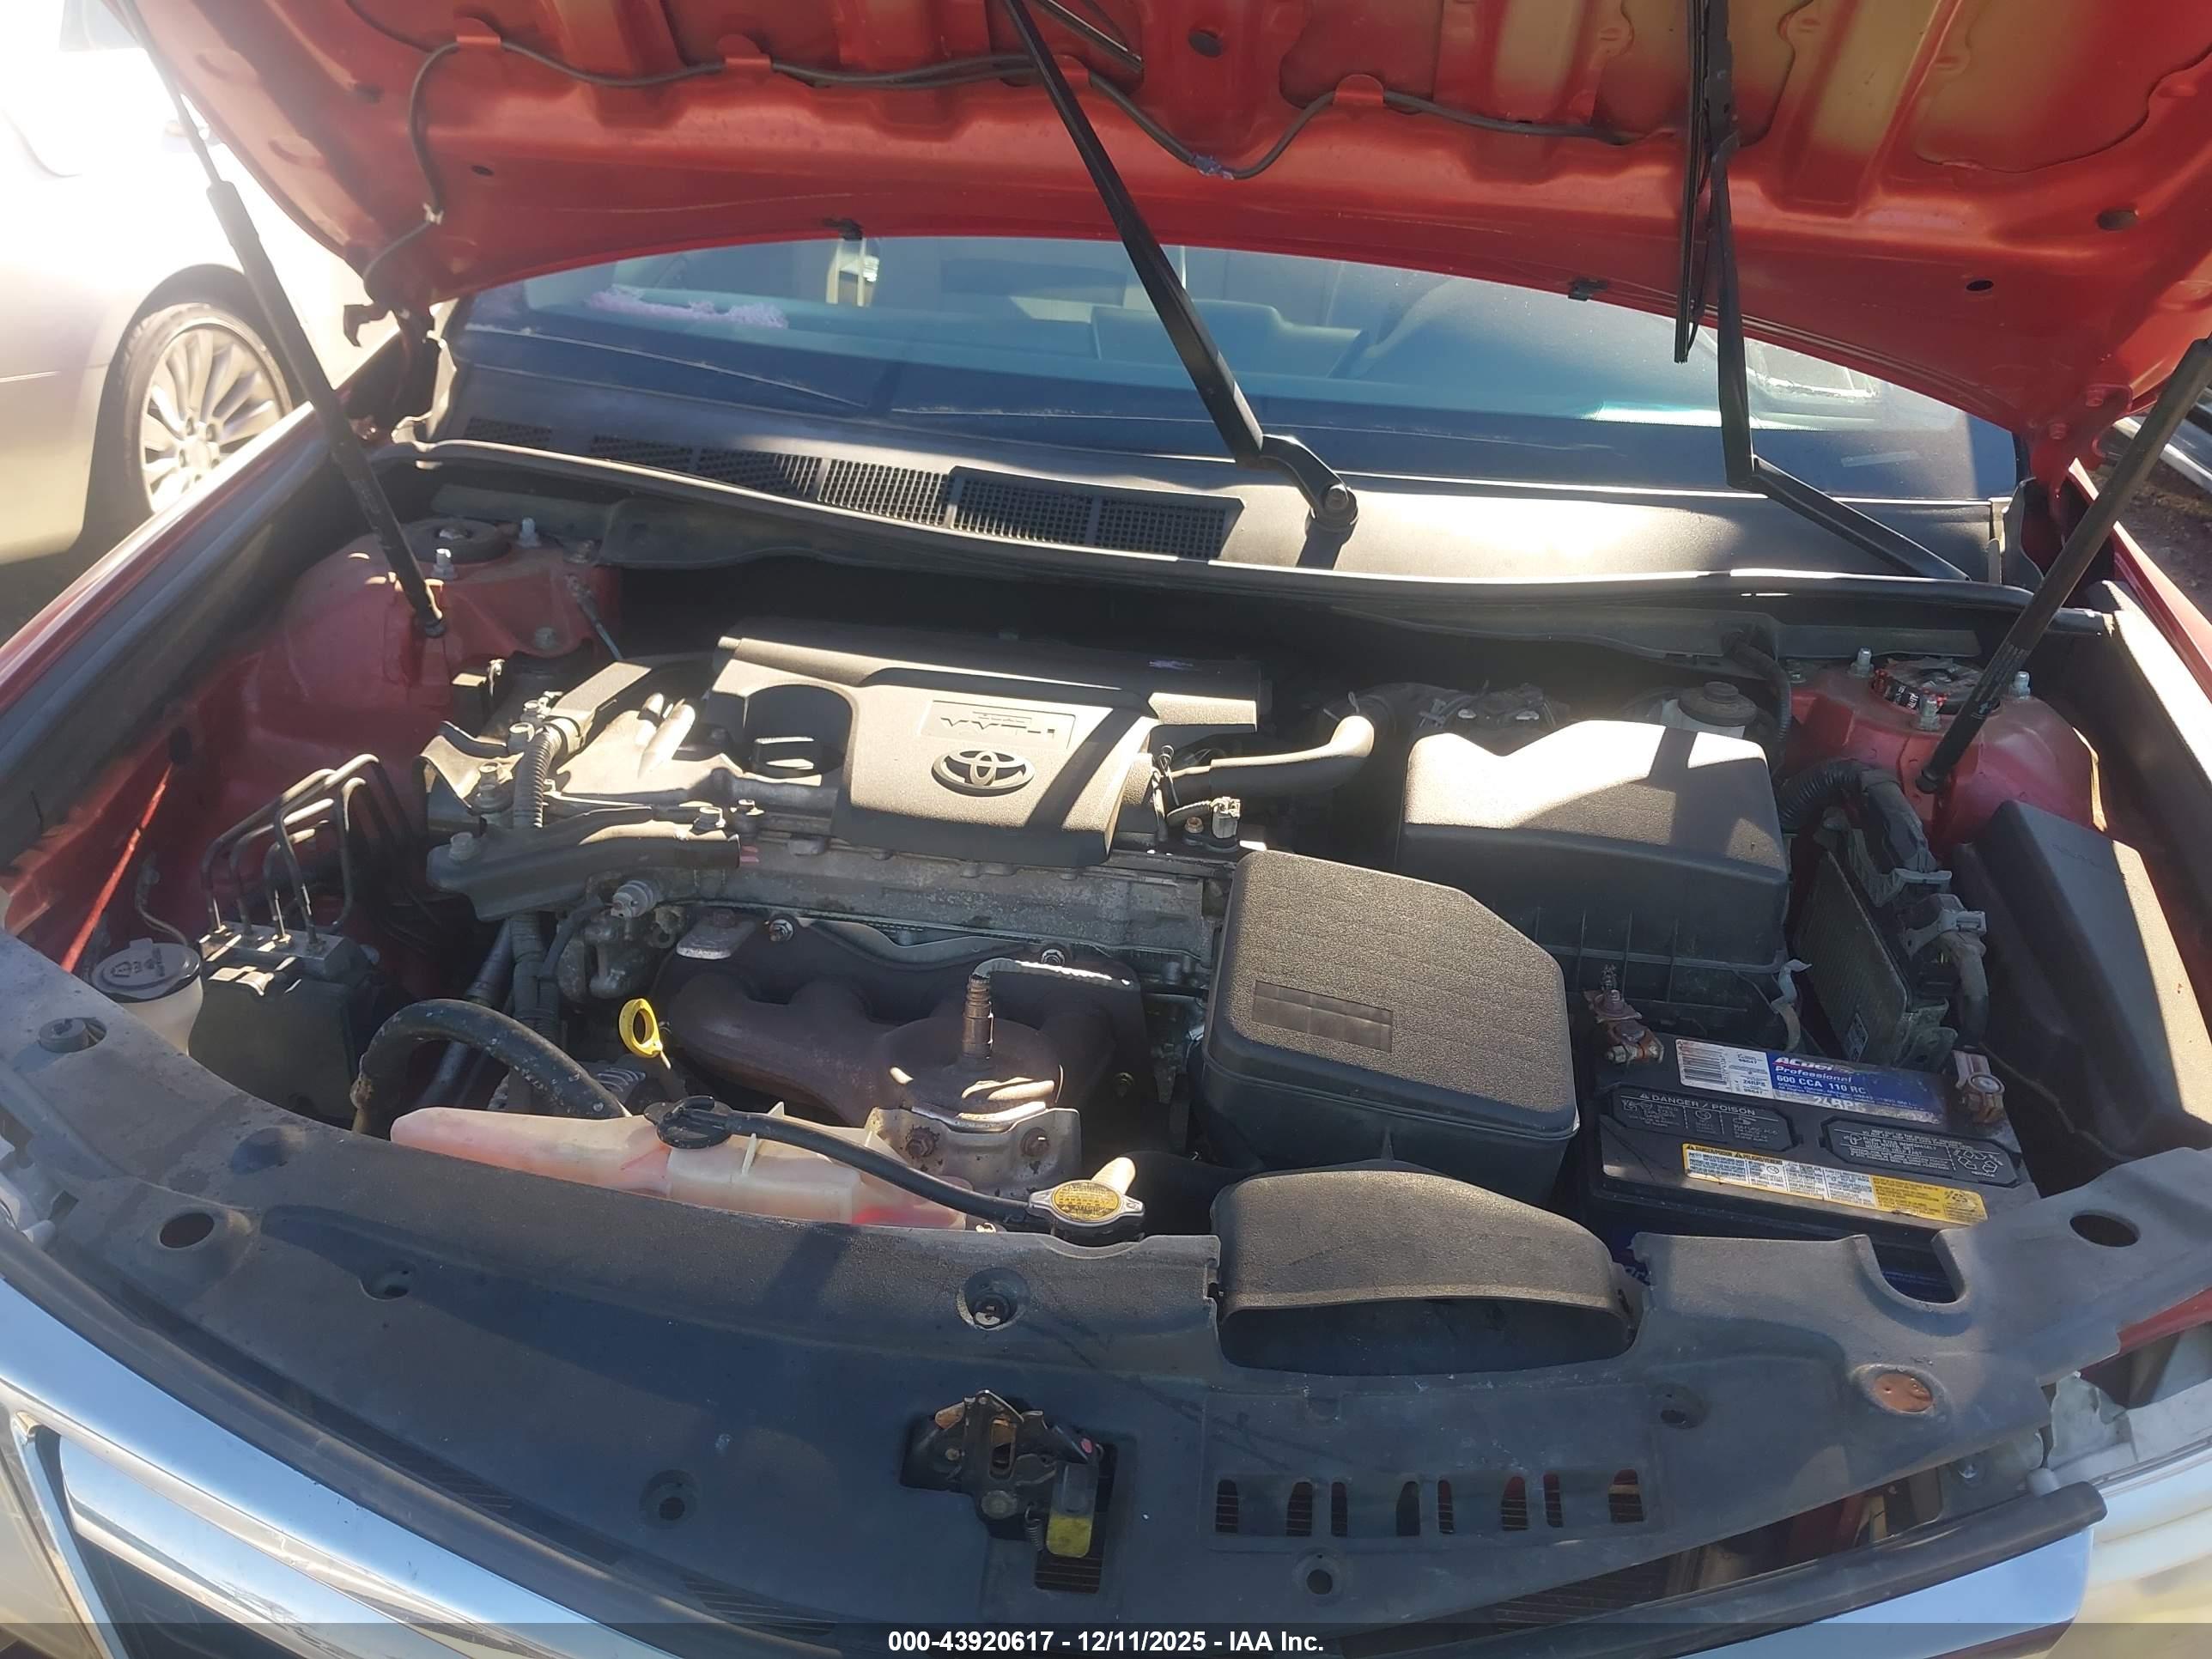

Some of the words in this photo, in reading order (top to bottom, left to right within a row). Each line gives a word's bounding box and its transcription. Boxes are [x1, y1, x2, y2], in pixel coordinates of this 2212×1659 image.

[1775, 1065, 1851, 1083] Professional
[1777, 1074, 1796, 1083] 600
[1798, 1077, 1822, 1087] CCA
[1828, 1082, 1847, 1091] 110
[1850, 1085, 1867, 1094] RC
[1652, 1095, 1698, 1106] DANGER
[1711, 1103, 1755, 1115] POISON
